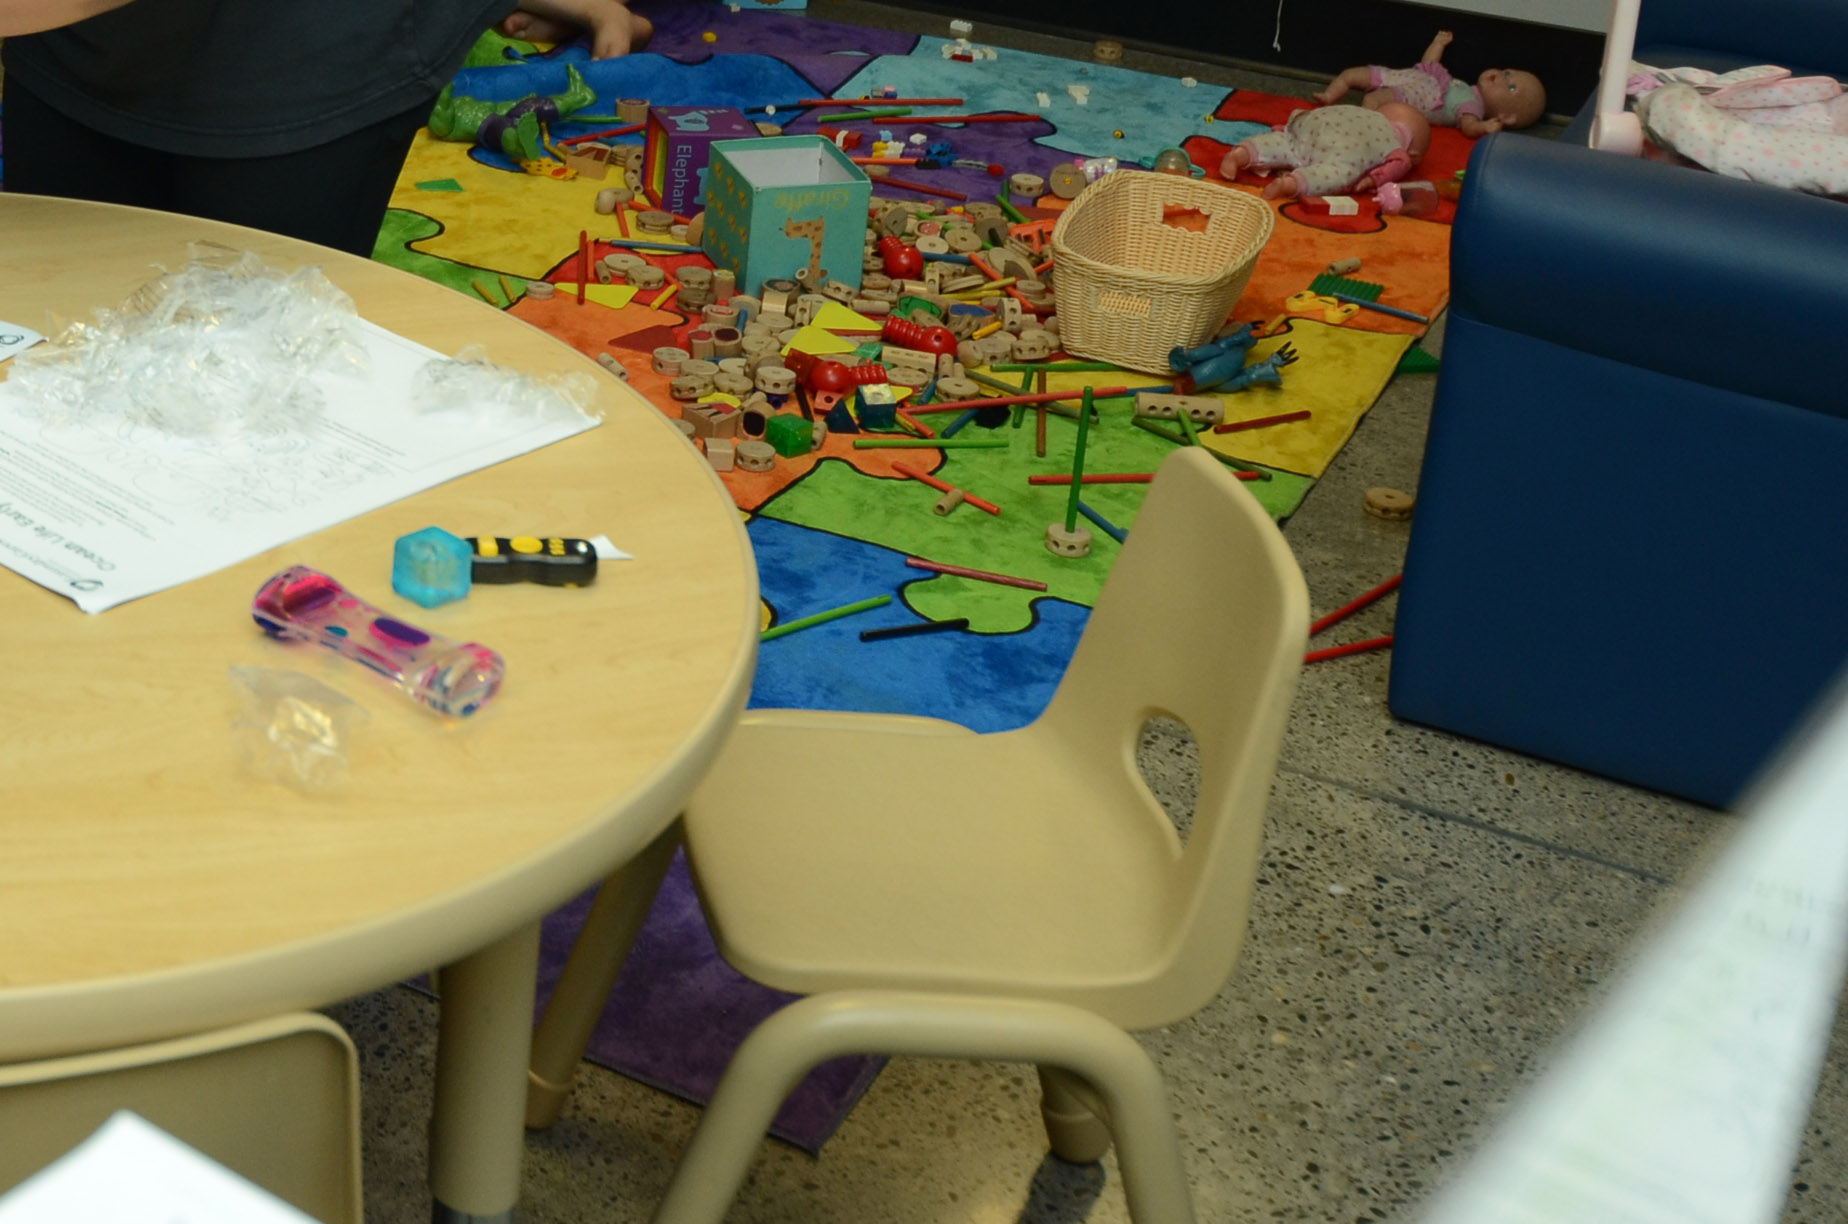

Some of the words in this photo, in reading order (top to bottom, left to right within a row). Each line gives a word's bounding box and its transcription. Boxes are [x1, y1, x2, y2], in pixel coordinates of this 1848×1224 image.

[672, 144, 693, 214] Elephant
[775, 187, 851, 214] Giraffe
[34, 526, 64, 543] Life
[64, 542, 115, 570] Ocean
